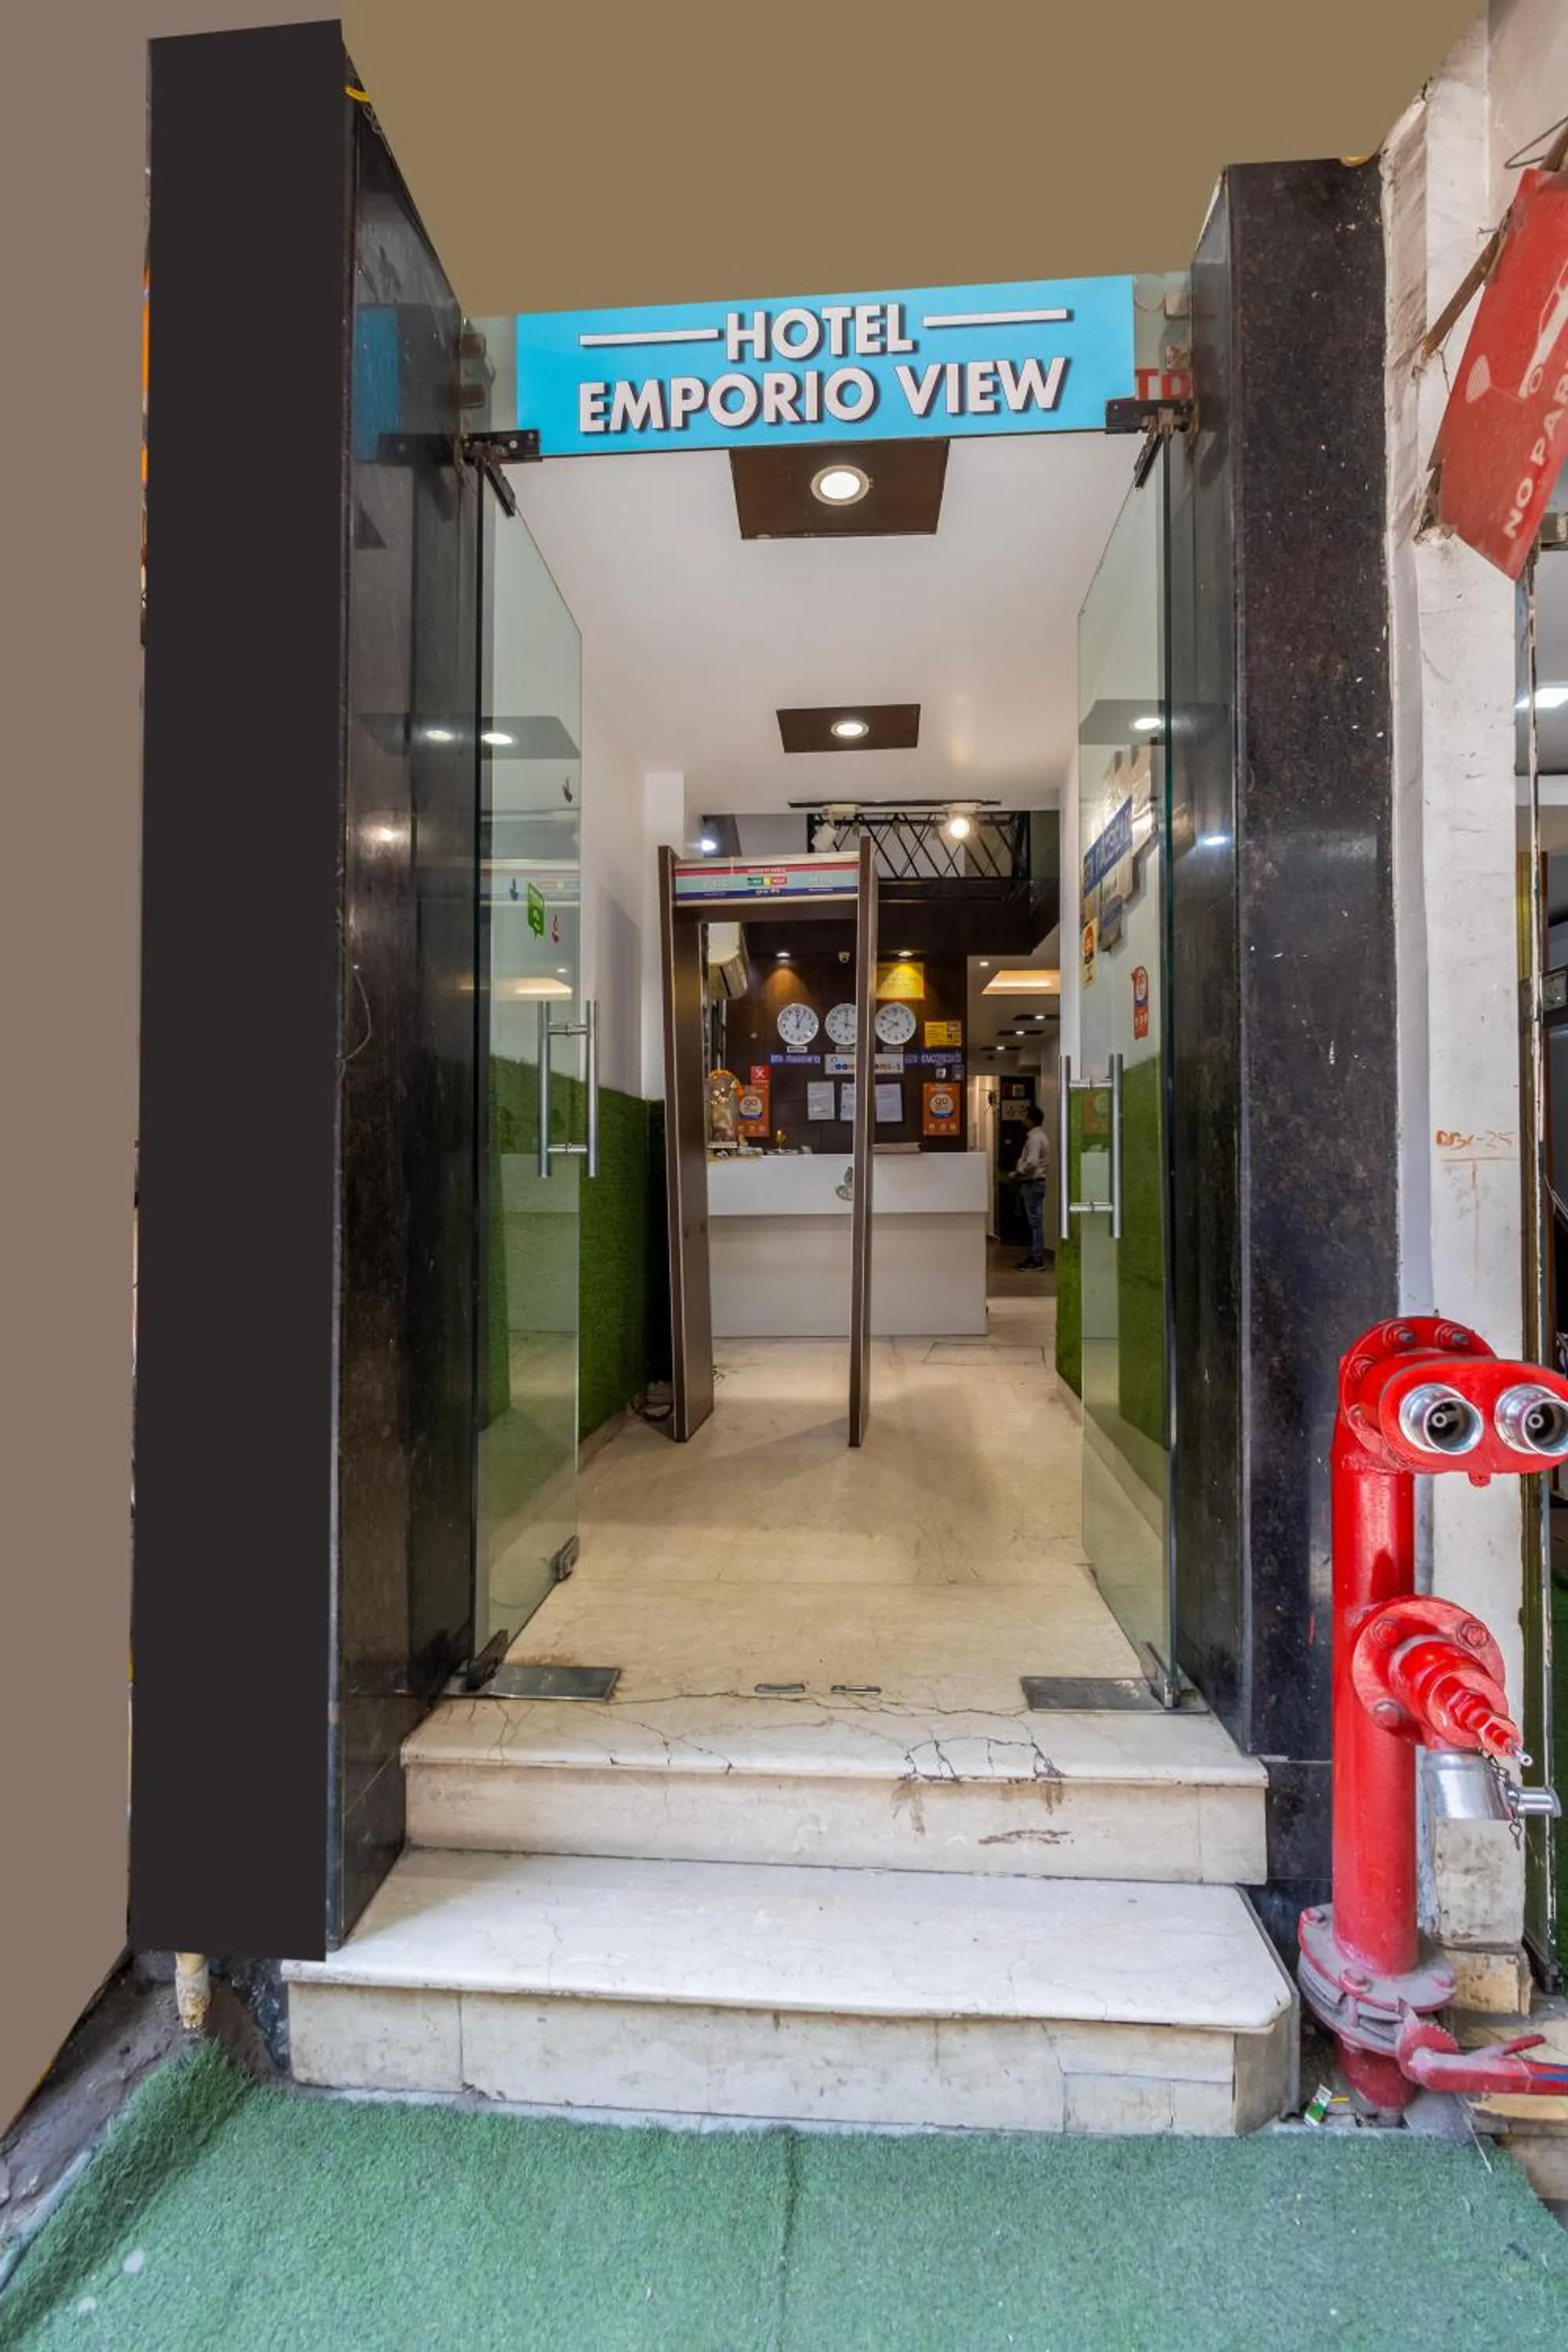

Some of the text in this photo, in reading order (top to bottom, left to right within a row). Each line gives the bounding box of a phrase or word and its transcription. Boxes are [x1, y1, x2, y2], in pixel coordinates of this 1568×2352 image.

[725, 303, 916, 361] HOTEL
[578, 357, 1069, 434] EMPORIO VIEW
[1502, 360, 1568, 539] NO PAR
